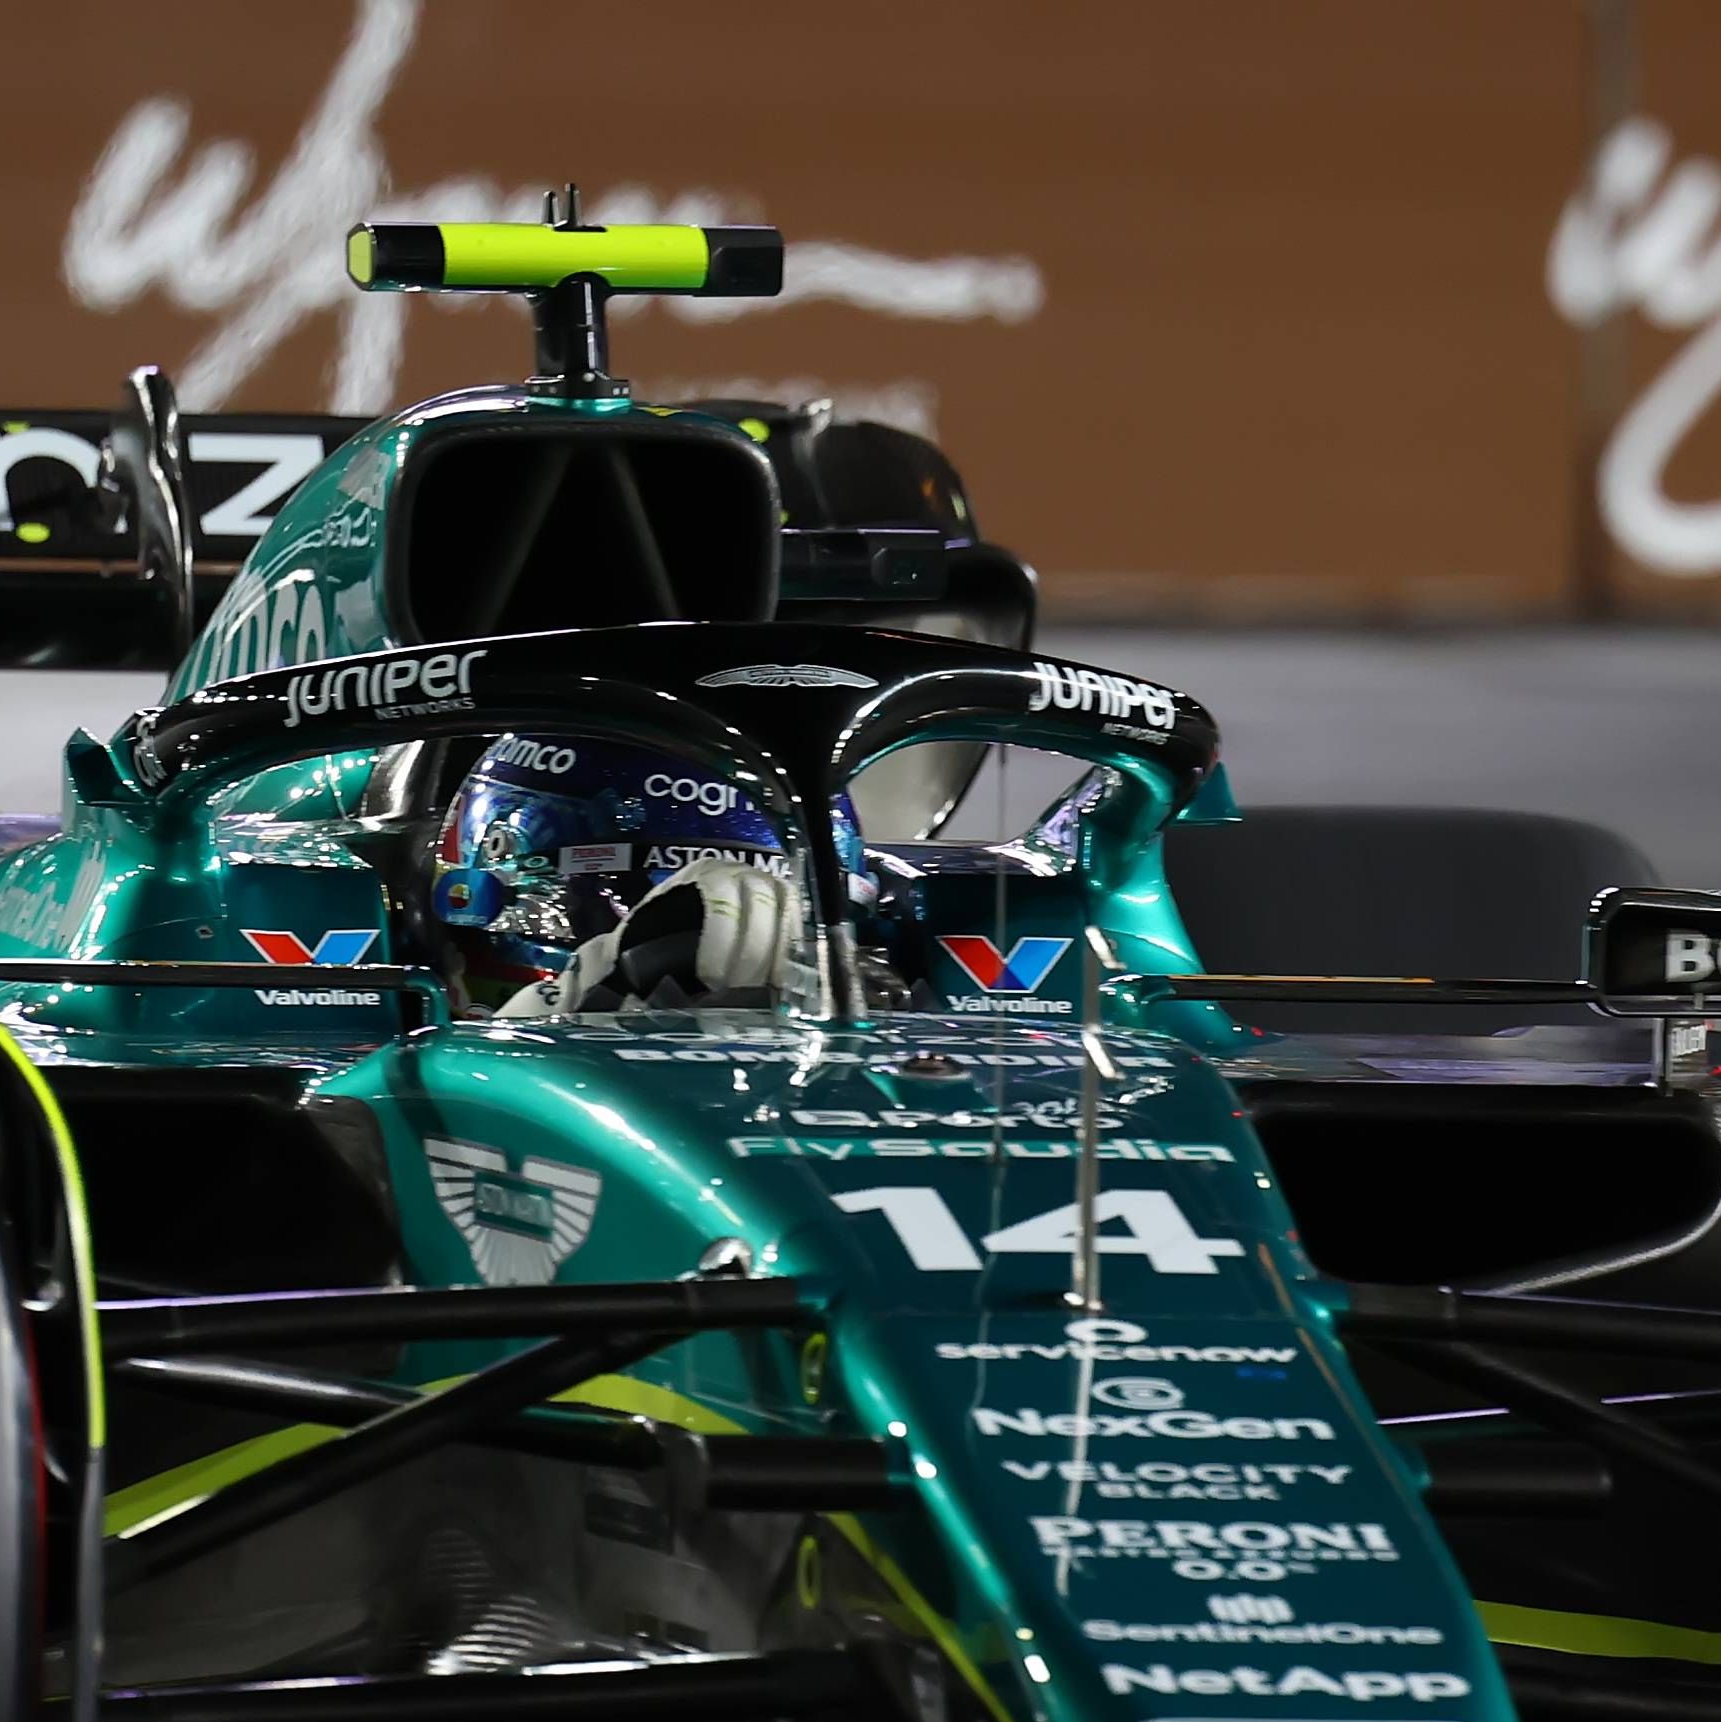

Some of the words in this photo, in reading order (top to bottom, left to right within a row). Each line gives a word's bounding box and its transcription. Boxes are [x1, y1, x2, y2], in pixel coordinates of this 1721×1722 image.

[254, 988, 381, 1006] Valvoline
[946, 994, 1073, 1014] Valvoline
[830, 1186, 1246, 1275] 14
[973, 1408, 1336, 1440] NexGen
[1000, 1460, 1353, 1485] VELOCITY
[1096, 1482, 1281, 1501] BLACK
[1029, 1515, 1393, 1552] PERONI
[1081, 1619, 1445, 1645] SentinelOne
[1100, 1663, 1471, 1702] NetApp
